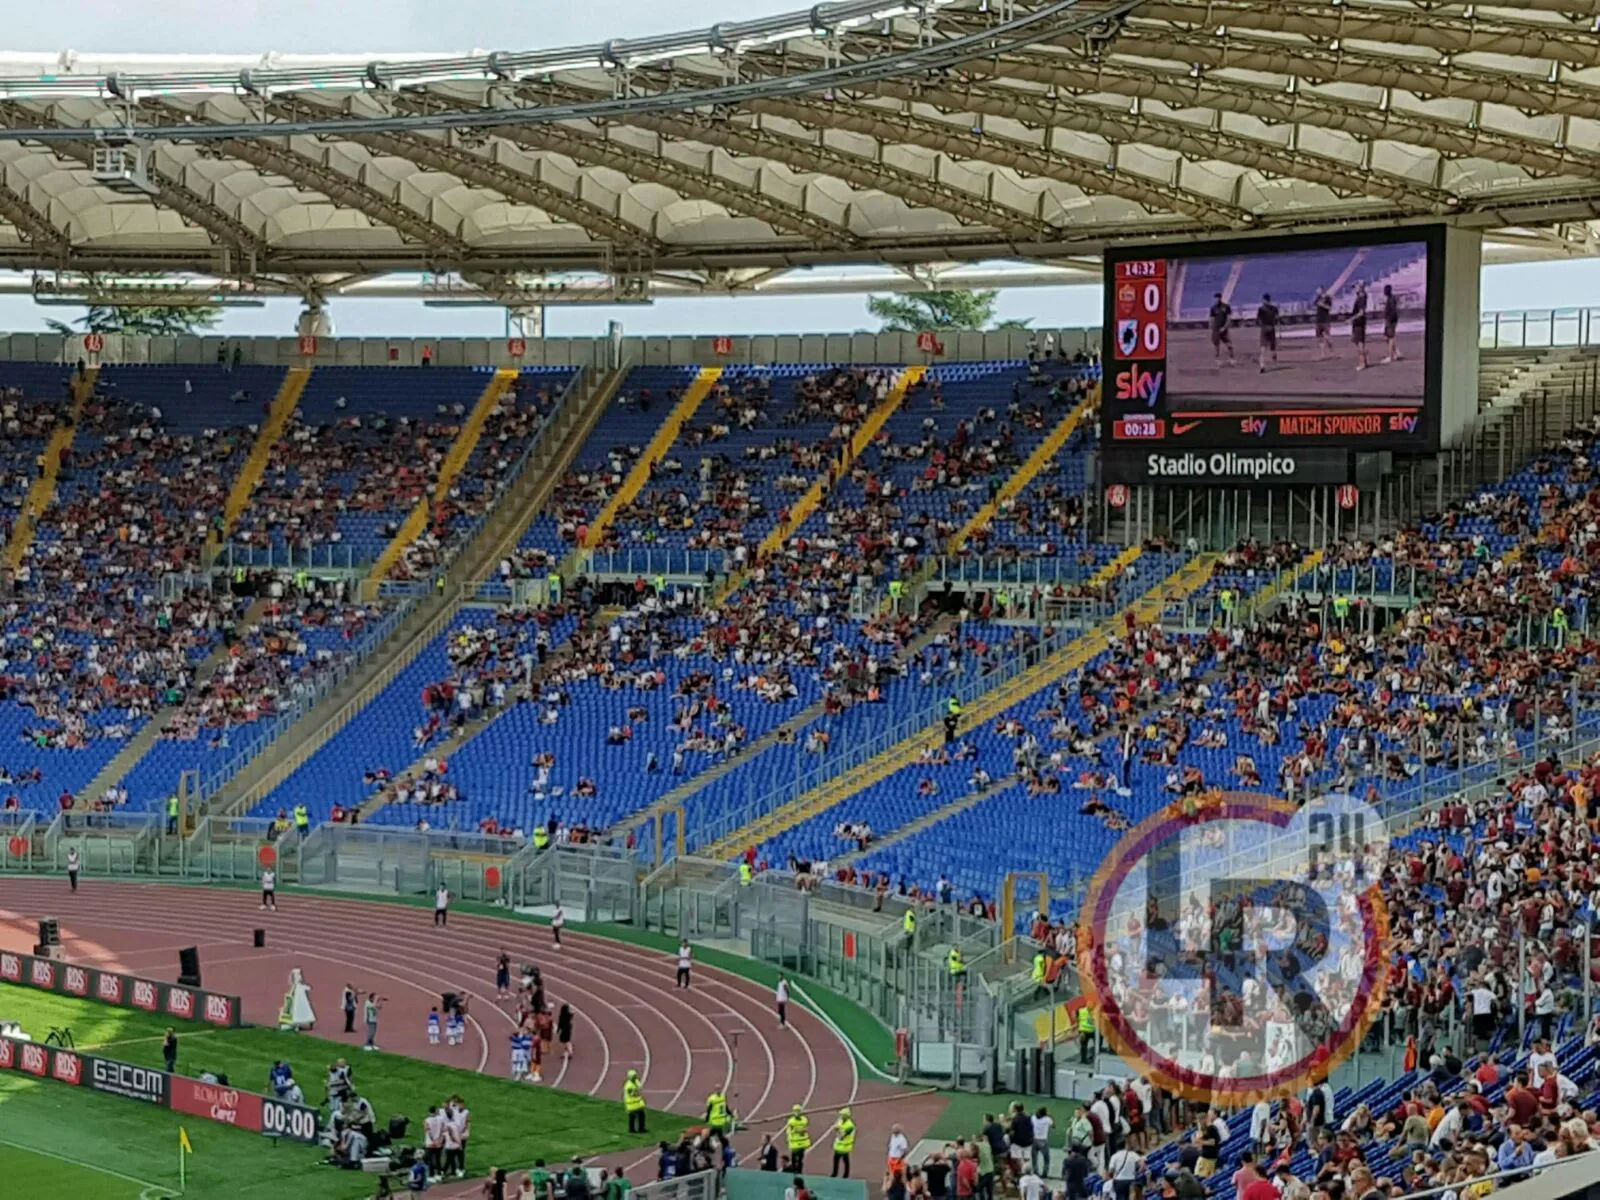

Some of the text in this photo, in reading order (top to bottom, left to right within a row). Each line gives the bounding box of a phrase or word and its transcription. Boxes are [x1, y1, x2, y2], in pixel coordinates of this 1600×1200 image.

[1144, 284, 1160, 312] 0
[1144, 322, 1160, 351] 0
[1116, 363, 1163, 407] sky
[1240, 413, 1419, 437] sky MATCH SPONSOR sky
[1148, 452, 1295, 480] Stadio Olimpico
[1, 953, 19, 977] RDS
[33, 960, 52, 985] RDS
[66, 966, 85, 989] RDS
[100, 973, 120, 997] RDS
[134, 980, 154, 1004] RDS
[171, 987, 191, 1011] RDS
[207, 995, 228, 1019] RDS
[23, 1043, 43, 1069] RDS
[55, 1052, 77, 1077] RDS
[263, 1102, 315, 1139] 00:00
